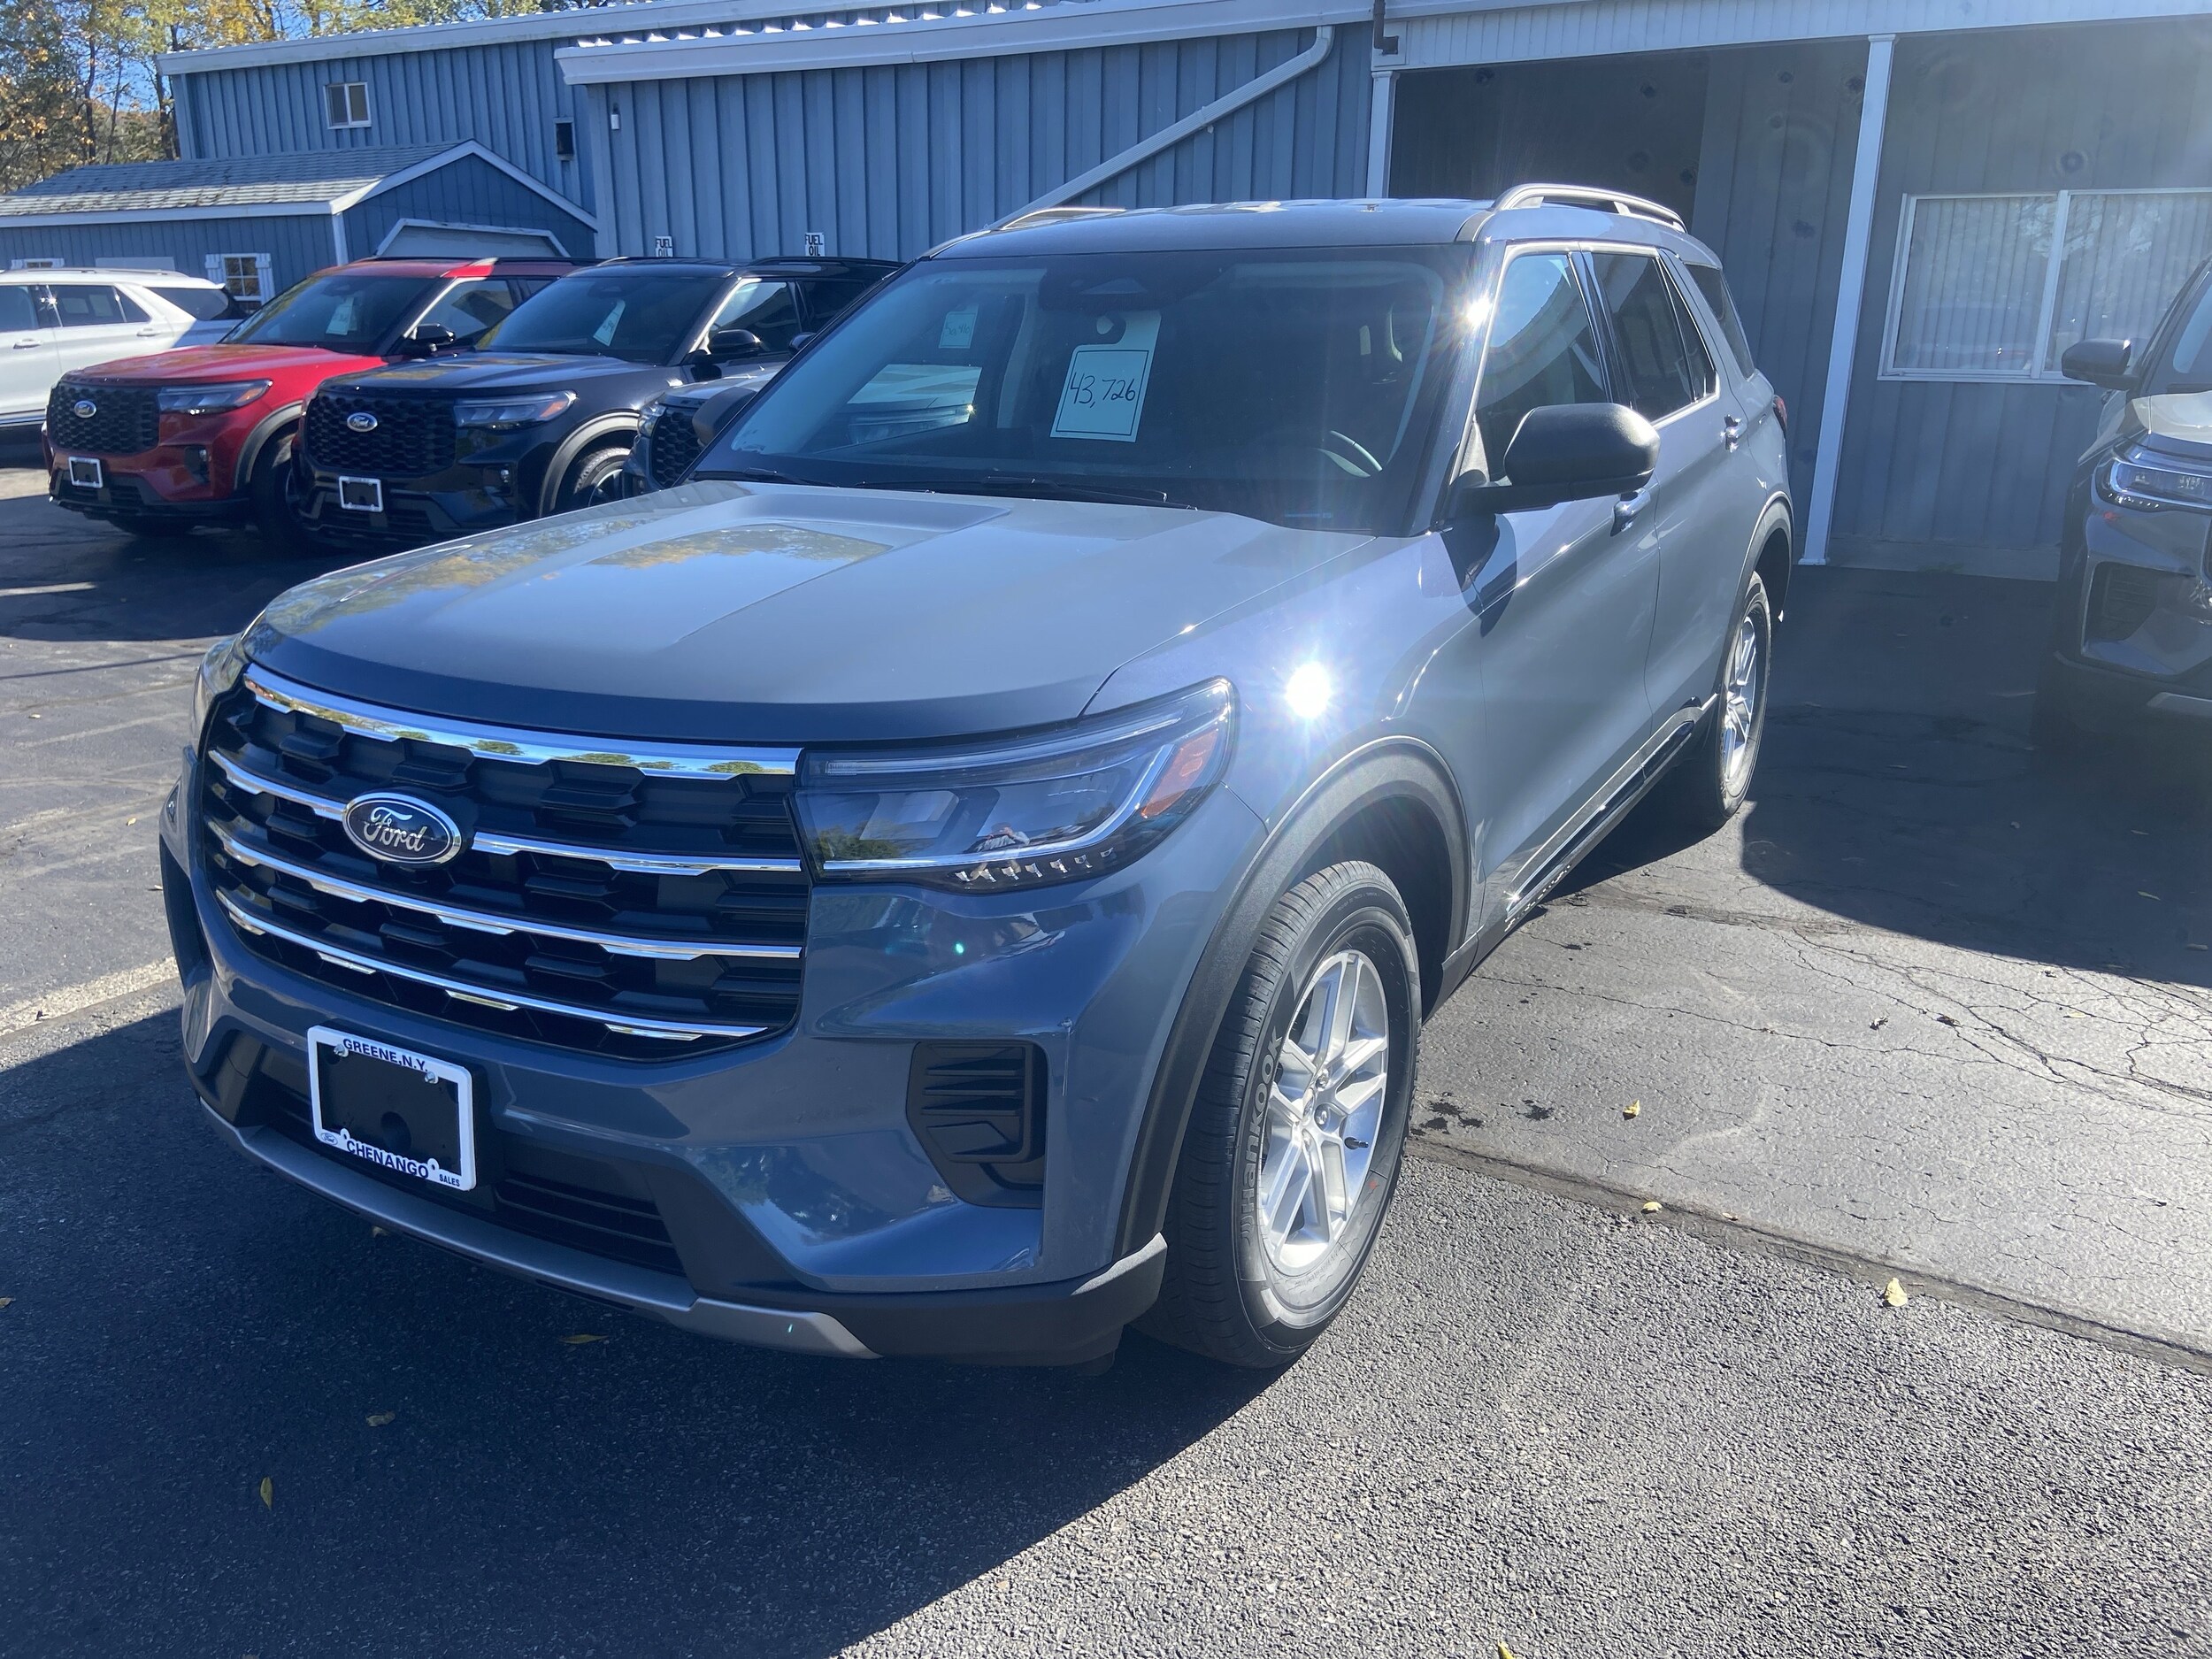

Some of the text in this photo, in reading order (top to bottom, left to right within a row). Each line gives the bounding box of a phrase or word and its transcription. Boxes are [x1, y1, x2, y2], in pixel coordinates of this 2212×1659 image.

[656, 238, 672, 248] FUEL
[805, 234, 823, 245] FUEL
[809, 245, 820, 256] OIL
[1069, 371, 1136, 409] 43,726
[363, 806, 428, 852] Ford
[347, 1140, 460, 1187] CHENANGO SALES
